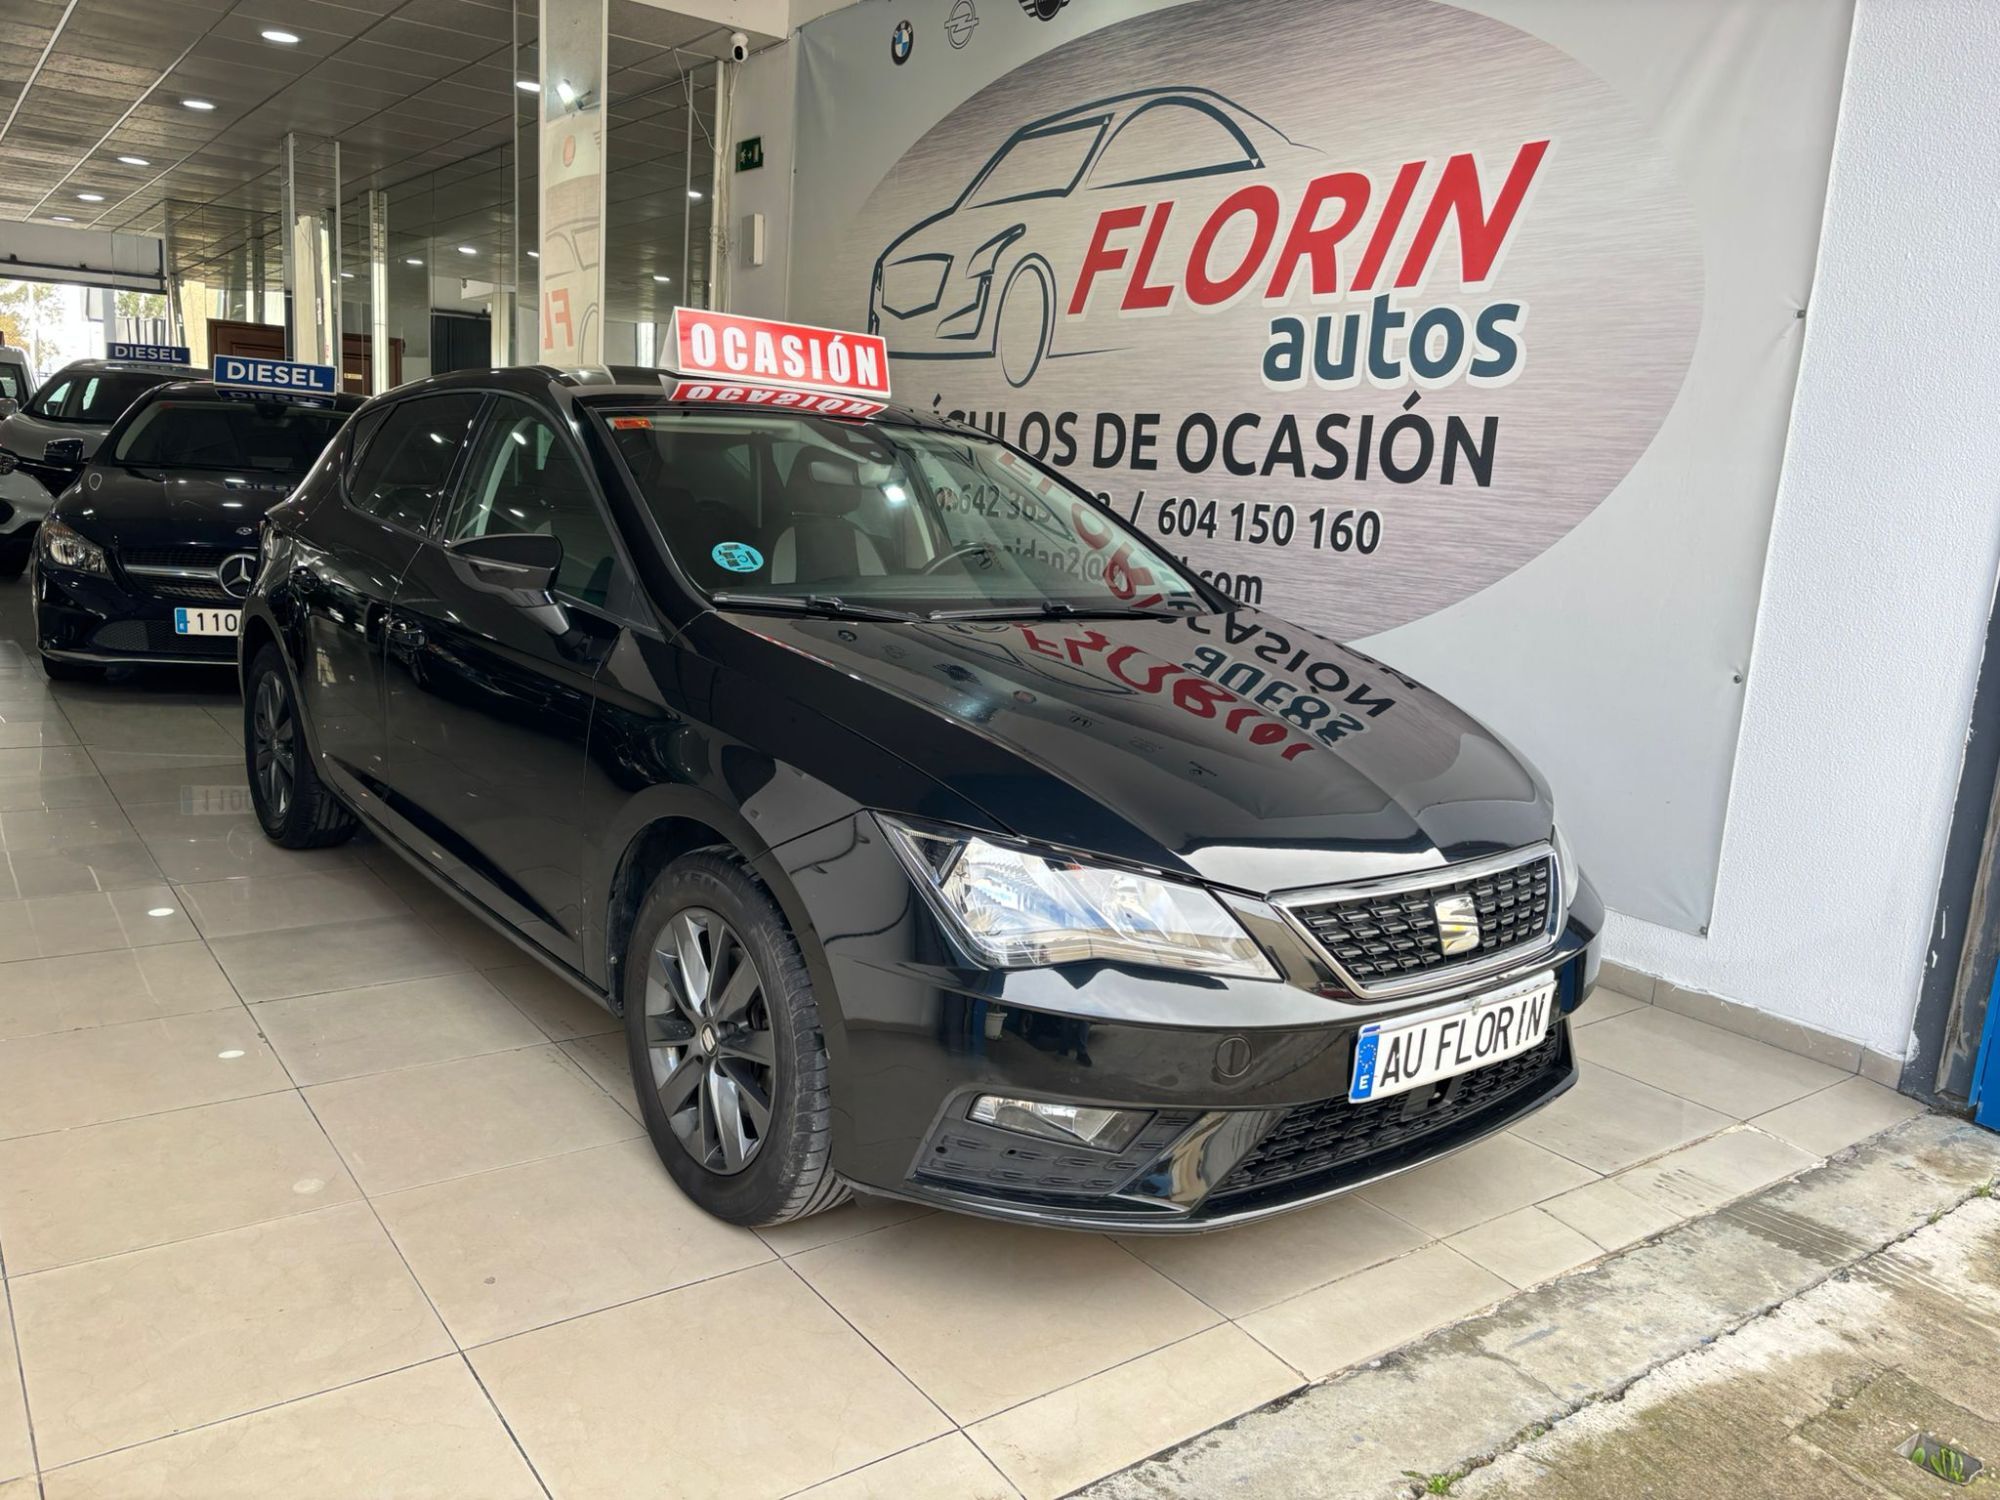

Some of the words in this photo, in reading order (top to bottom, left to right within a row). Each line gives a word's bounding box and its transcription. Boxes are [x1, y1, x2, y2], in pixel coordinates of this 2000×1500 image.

[1067, 139, 1551, 315] FLORIN
[114, 346, 182, 361] DIESEL
[690, 322, 879, 387] OCASIÓN
[1262, 293, 1521, 381] autos
[226, 361, 324, 387] DIESEL
[1092, 412, 1161, 470] DE
[1176, 390, 1499, 487] OCASIÓN
[1158, 497, 1217, 539] 604
[1230, 502, 1295, 546] 150
[1309, 507, 1382, 554] 160
[1358, 1075, 1370, 1090] E
[1378, 1028, 1428, 1088] AU
